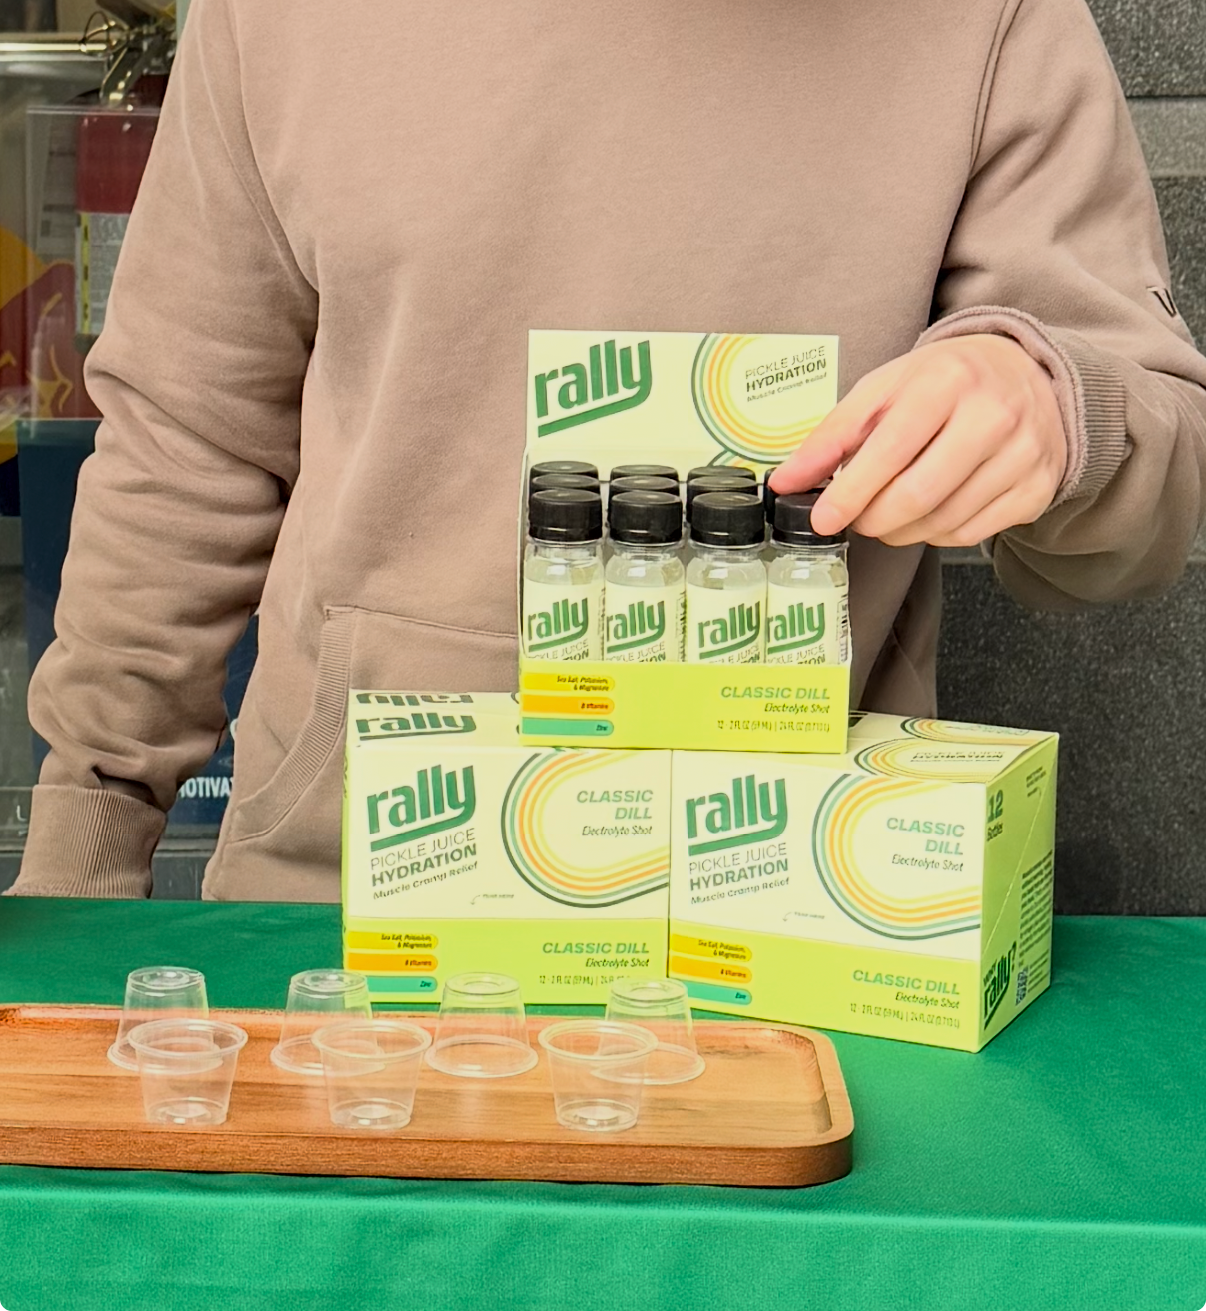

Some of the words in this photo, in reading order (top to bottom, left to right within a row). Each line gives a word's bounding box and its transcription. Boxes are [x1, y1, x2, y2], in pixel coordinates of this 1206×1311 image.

[745, 357, 788, 379] PICKLE
[791, 346, 825, 365] JUICE
[746, 358, 827, 392] HYDRATION
[535, 339, 653, 438] rally
[528, 598, 589, 653] rally
[606, 600, 666, 654] rally
[698, 601, 761, 660] rally
[767, 603, 826, 655] rally
[720, 686, 792, 699] CLASSIC
[795, 687, 831, 700] DILL
[764, 703, 809, 715] Electrolyte
[810, 704, 830, 714] Shot
[356, 713, 477, 741] rally
[178, 777, 233, 798] OTIVA
[576, 790, 654, 803] CLASSIC
[367, 764, 477, 853] rally
[615, 807, 653, 820] DILL
[686, 774, 788, 857] rally
[987, 789, 1003, 823] 12
[582, 825, 630, 838] Electrolyte
[631, 825, 653, 836] Shot
[886, 817, 965, 838] CLASSIC
[370, 842, 427, 871] PICKLE
[431, 828, 476, 853] JUICE
[689, 852, 740, 875] PICKLE
[745, 842, 787, 864] JUICE
[925, 839, 963, 856] DILL
[372, 843, 477, 887] HYDRATION
[689, 858, 789, 892] HYDRATION
[891, 854, 940, 870] Electrolyte
[942, 859, 964, 872] Shot
[373, 883, 411, 900] Muscle
[413, 872, 447, 889] Cramp
[449, 861, 478, 877] Relief
[690, 891, 725, 905] Muscle
[727, 885, 760, 898] Cramp
[762, 877, 790, 890] Relief
[542, 942, 612, 954] CLASSIC
[615, 942, 650, 954] DILL
[585, 957, 629, 969] Electrolyte
[630, 958, 650, 967] Shot
[852, 969, 922, 990] CLASSIC
[926, 979, 960, 995] DILL
[895, 991, 939, 1006] Electrolyte
[940, 997, 960, 1009] Shot
